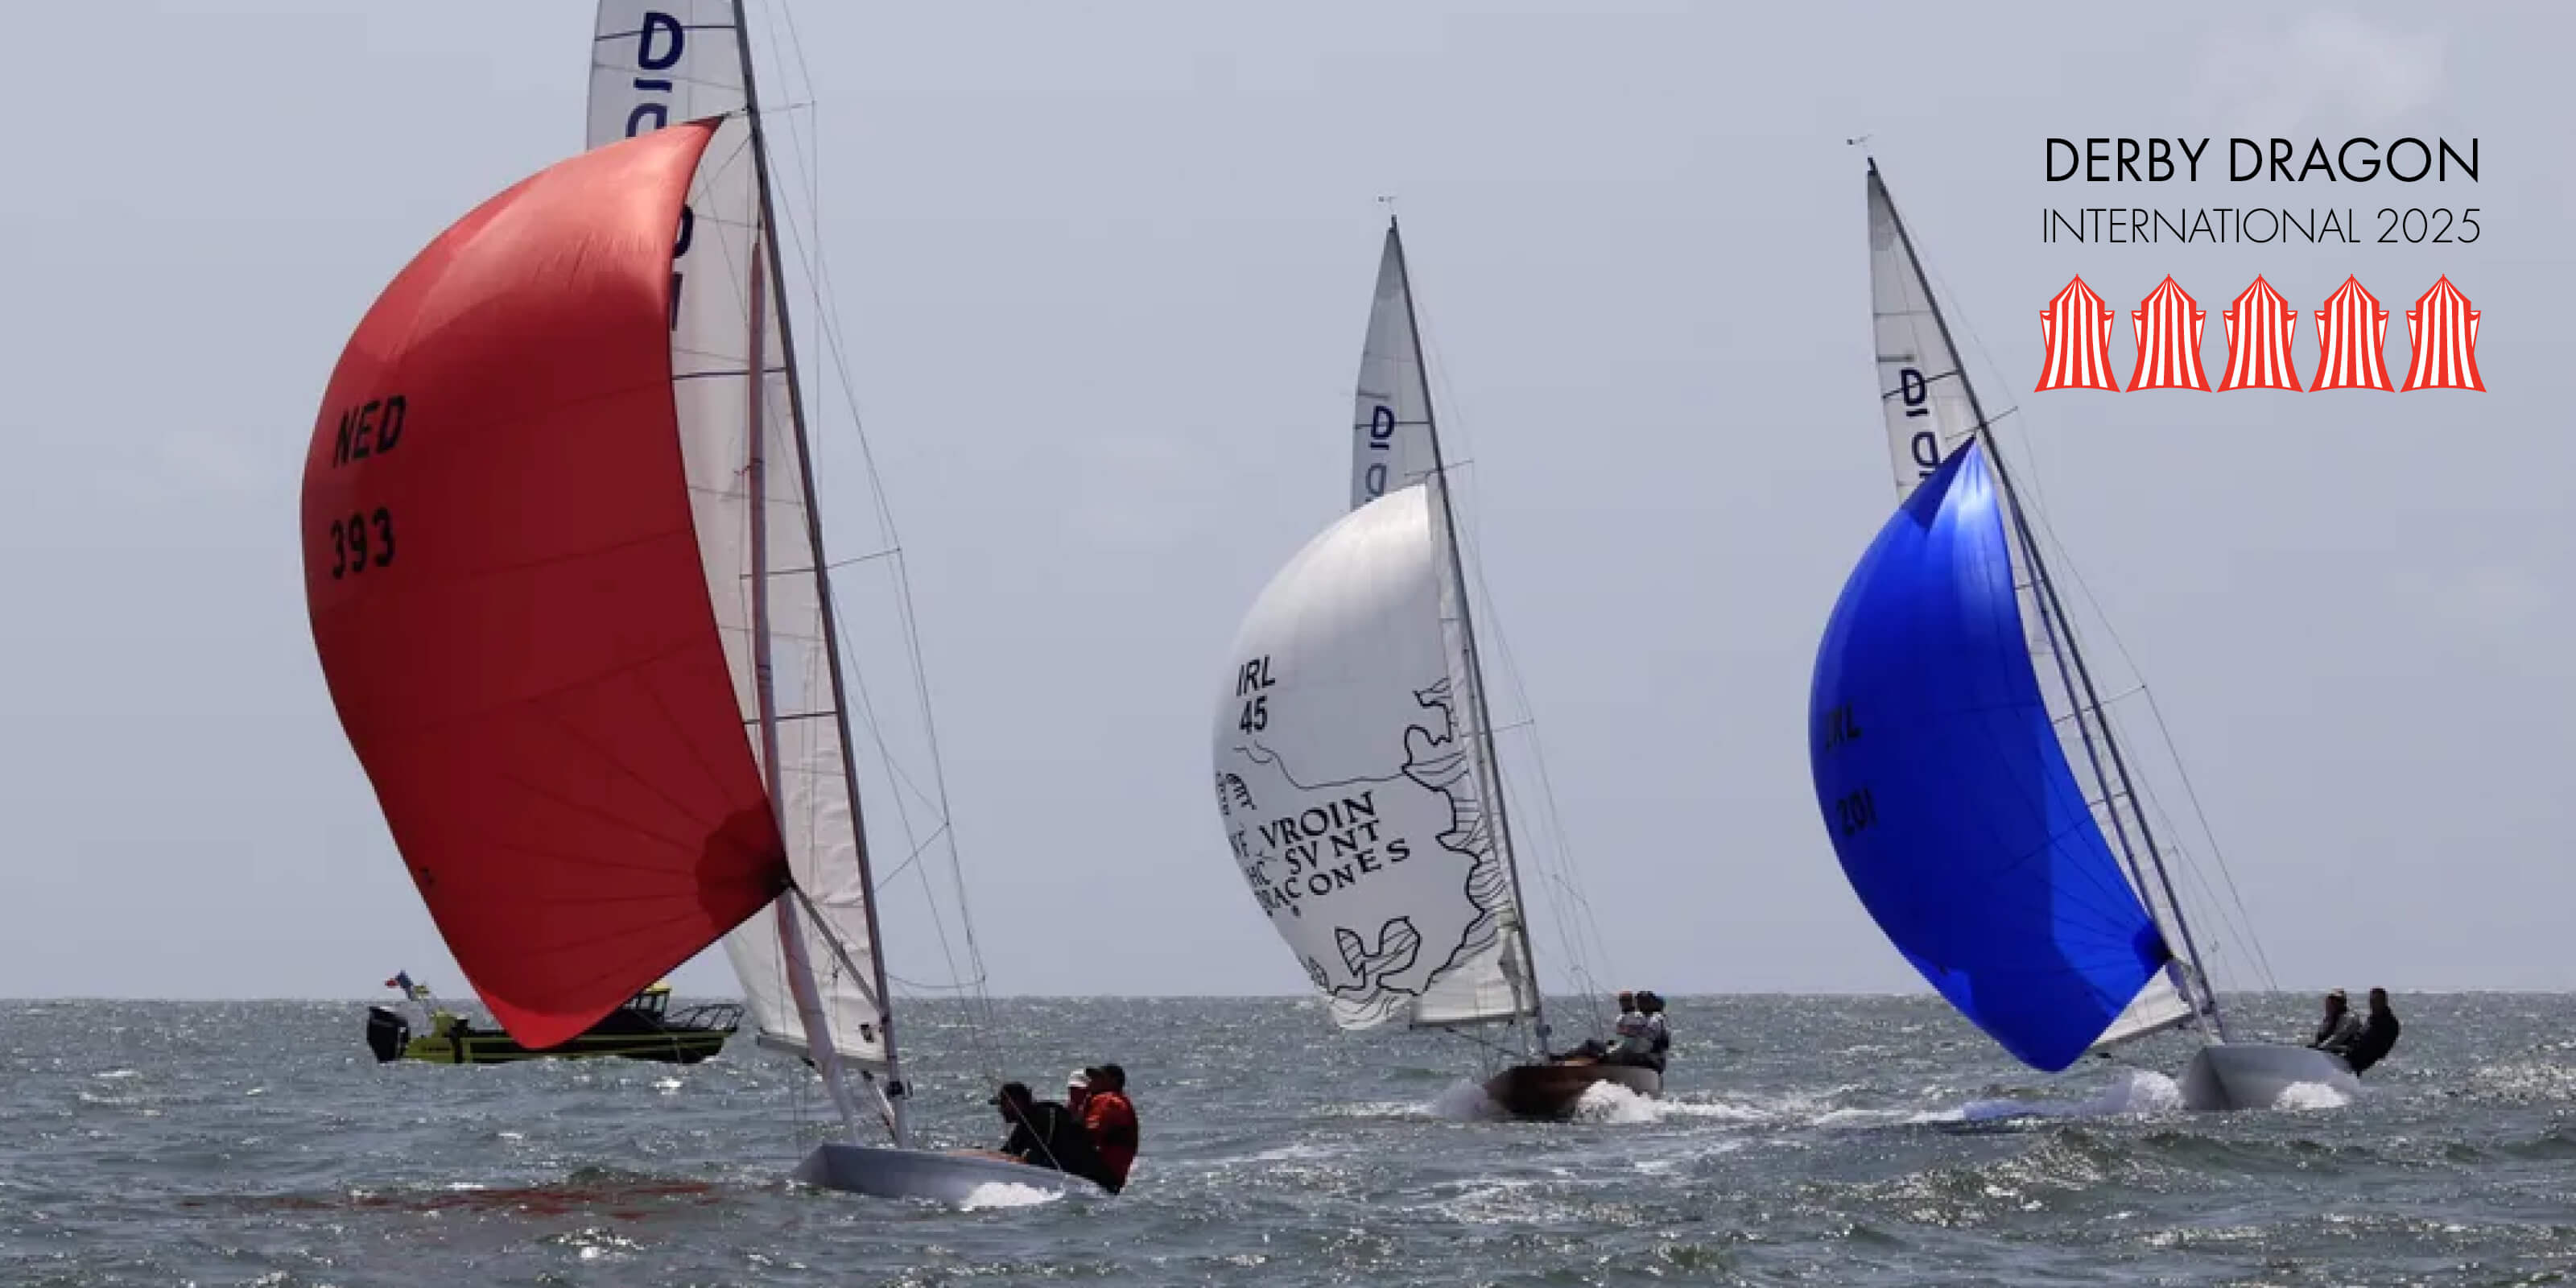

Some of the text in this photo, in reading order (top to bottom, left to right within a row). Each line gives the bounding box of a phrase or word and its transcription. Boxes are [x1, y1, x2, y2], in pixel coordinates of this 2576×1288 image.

[332, 394, 407, 469] NED
[331, 506, 395, 580] 393
[1236, 654, 1276, 696] IRL
[1238, 695, 1268, 734] 45
[1258, 790, 1375, 848] VROIN
